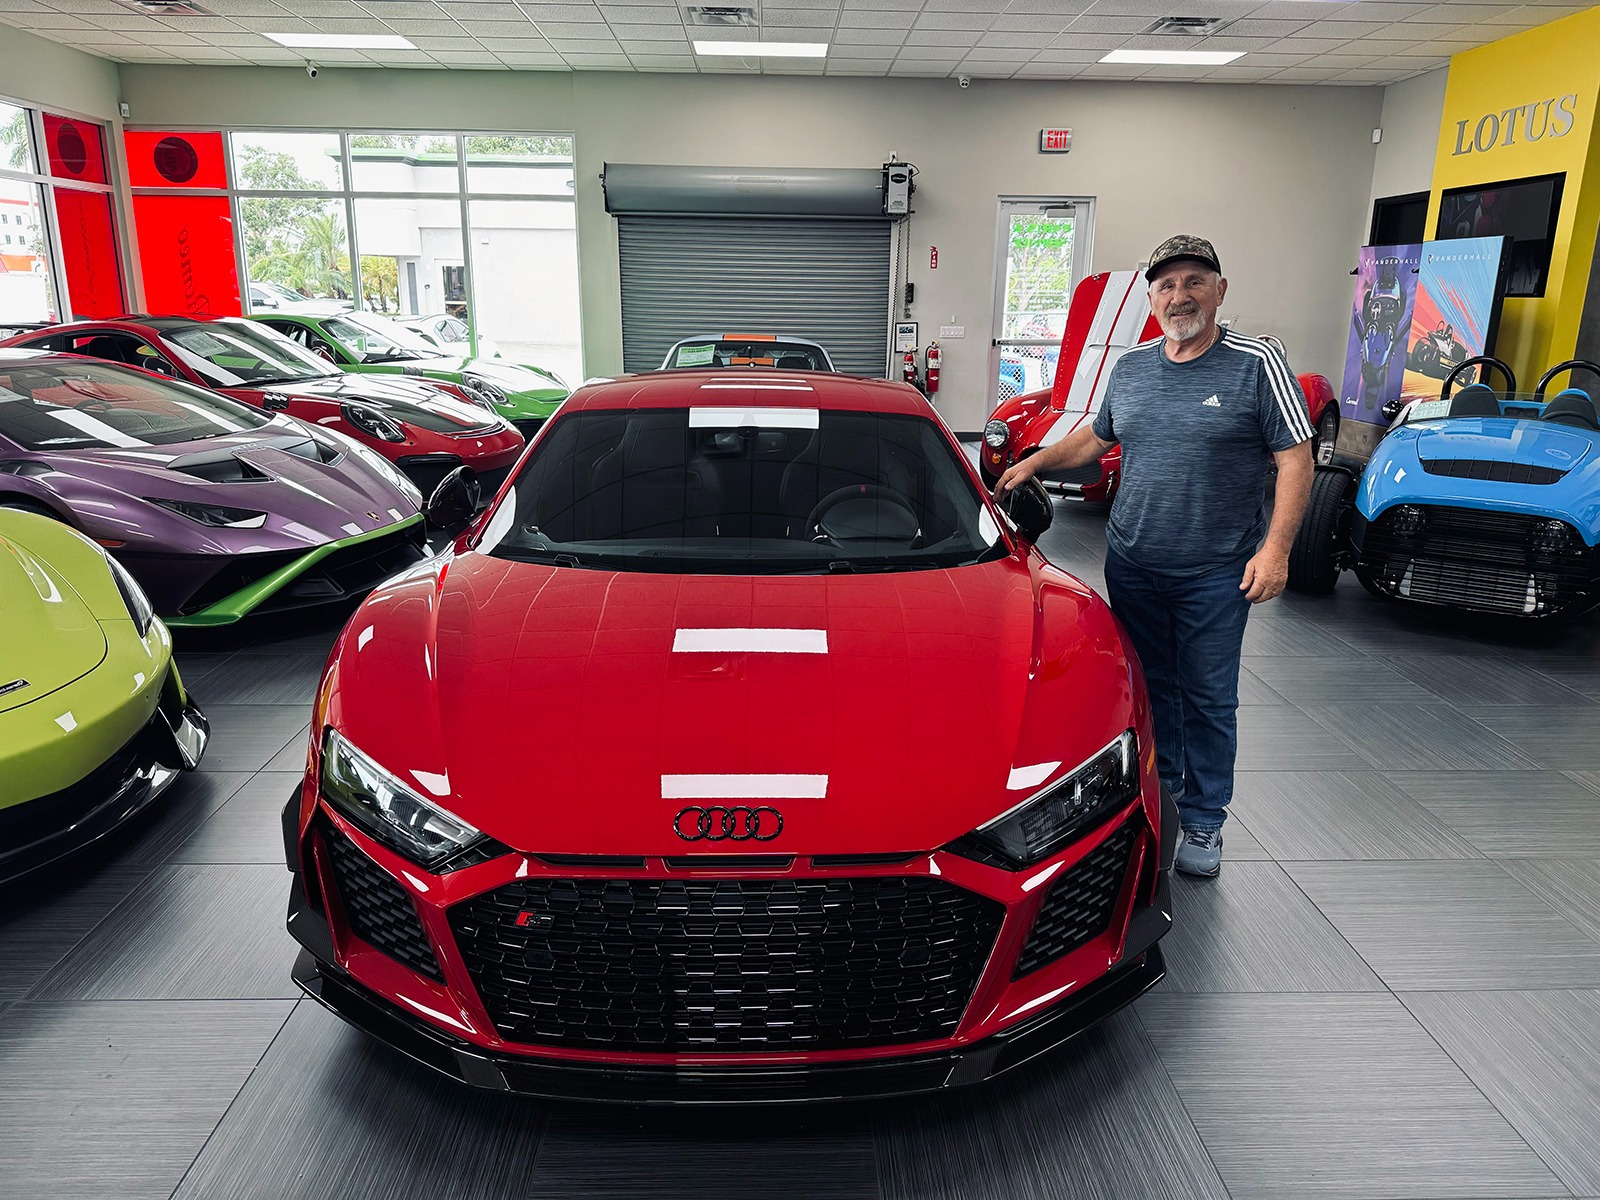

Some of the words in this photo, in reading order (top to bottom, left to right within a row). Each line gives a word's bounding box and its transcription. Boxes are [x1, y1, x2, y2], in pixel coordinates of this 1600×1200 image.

[1452, 94, 1577, 156] LOTUS
[1047, 130, 1069, 149] EXIT
[1436, 254, 1492, 262] VANDERHALL
